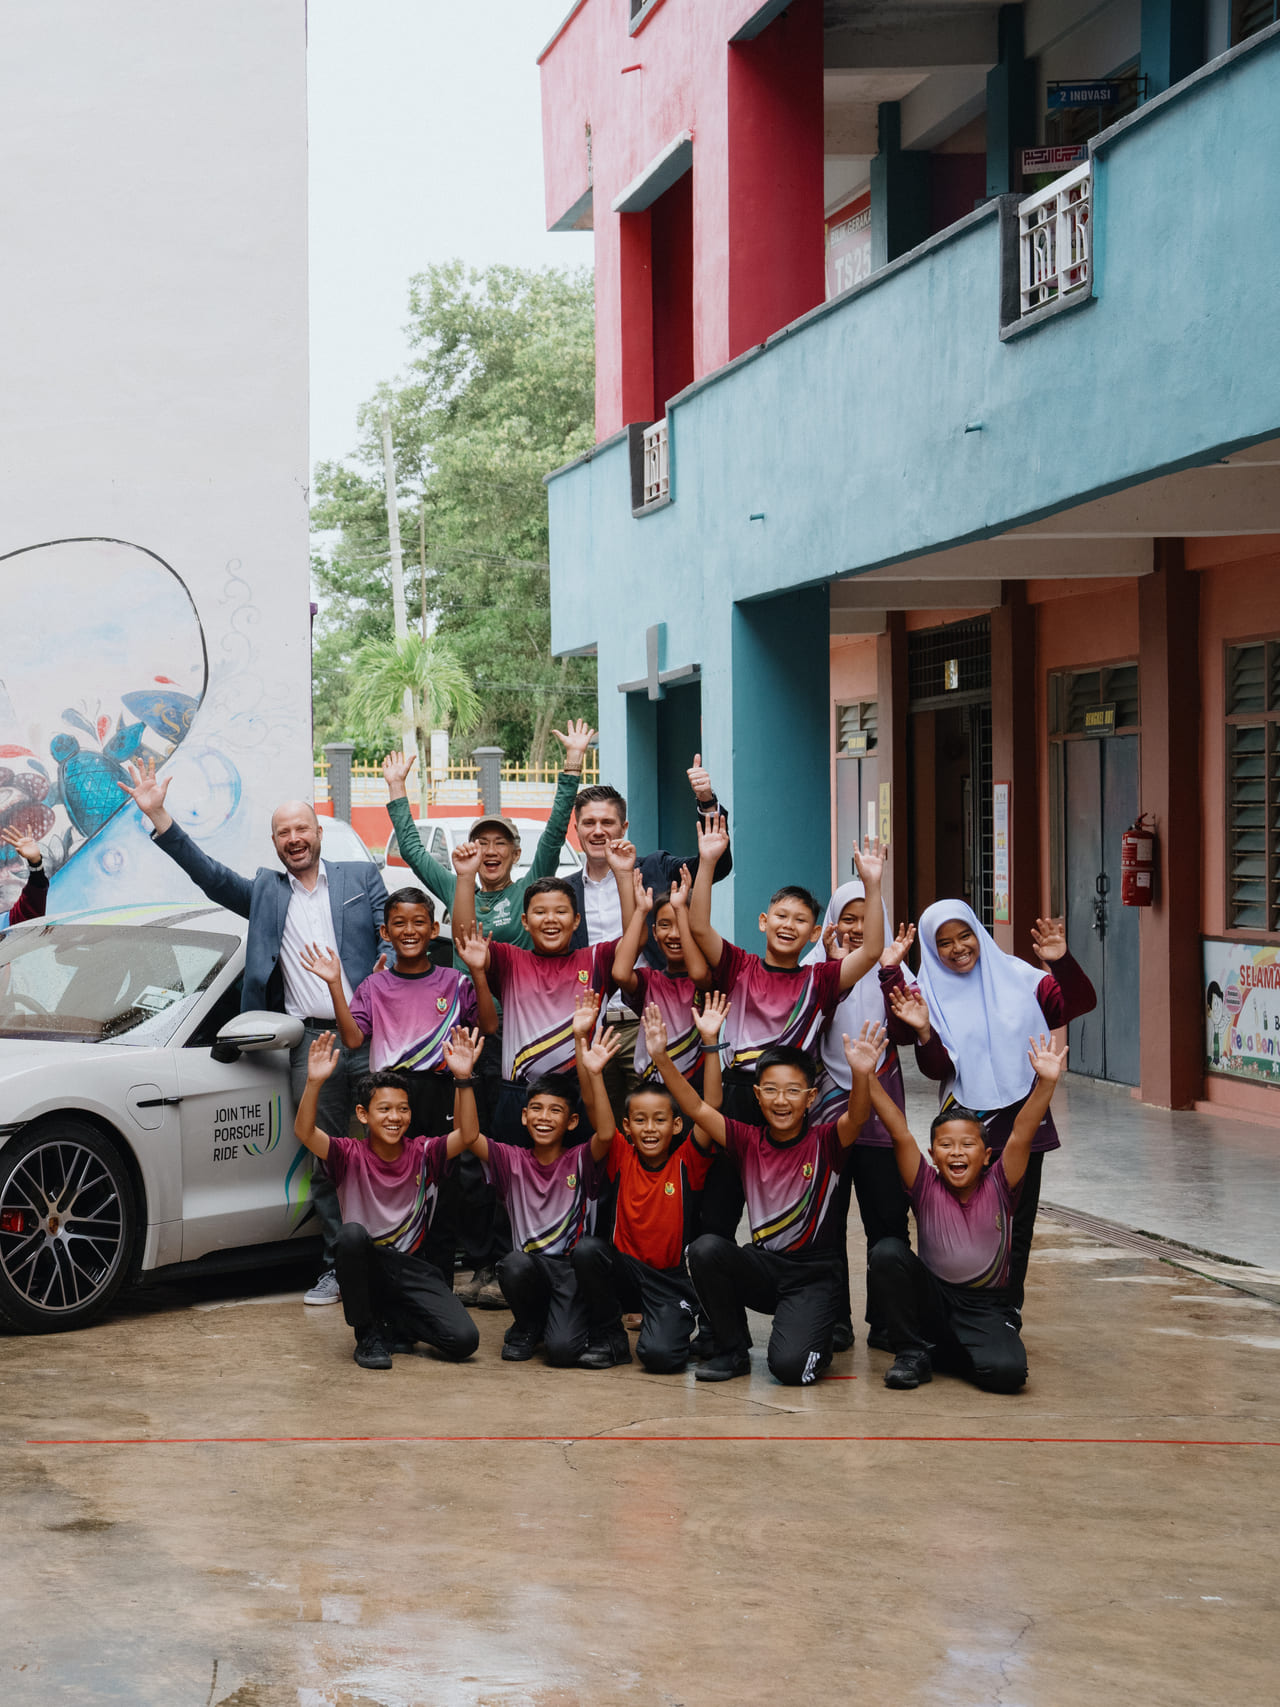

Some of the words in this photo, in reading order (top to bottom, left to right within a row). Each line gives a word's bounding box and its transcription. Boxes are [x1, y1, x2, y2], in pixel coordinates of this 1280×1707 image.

[1060, 91, 1068, 102] 2
[1070, 89, 1111, 101] INOVASI
[1231, 1028, 1254, 1051] Reka
[214, 1107, 238, 1123] JOIN
[239, 1104, 261, 1119] THE
[214, 1123, 265, 1142] PORSCHE
[213, 1146, 239, 1161] RIDE
